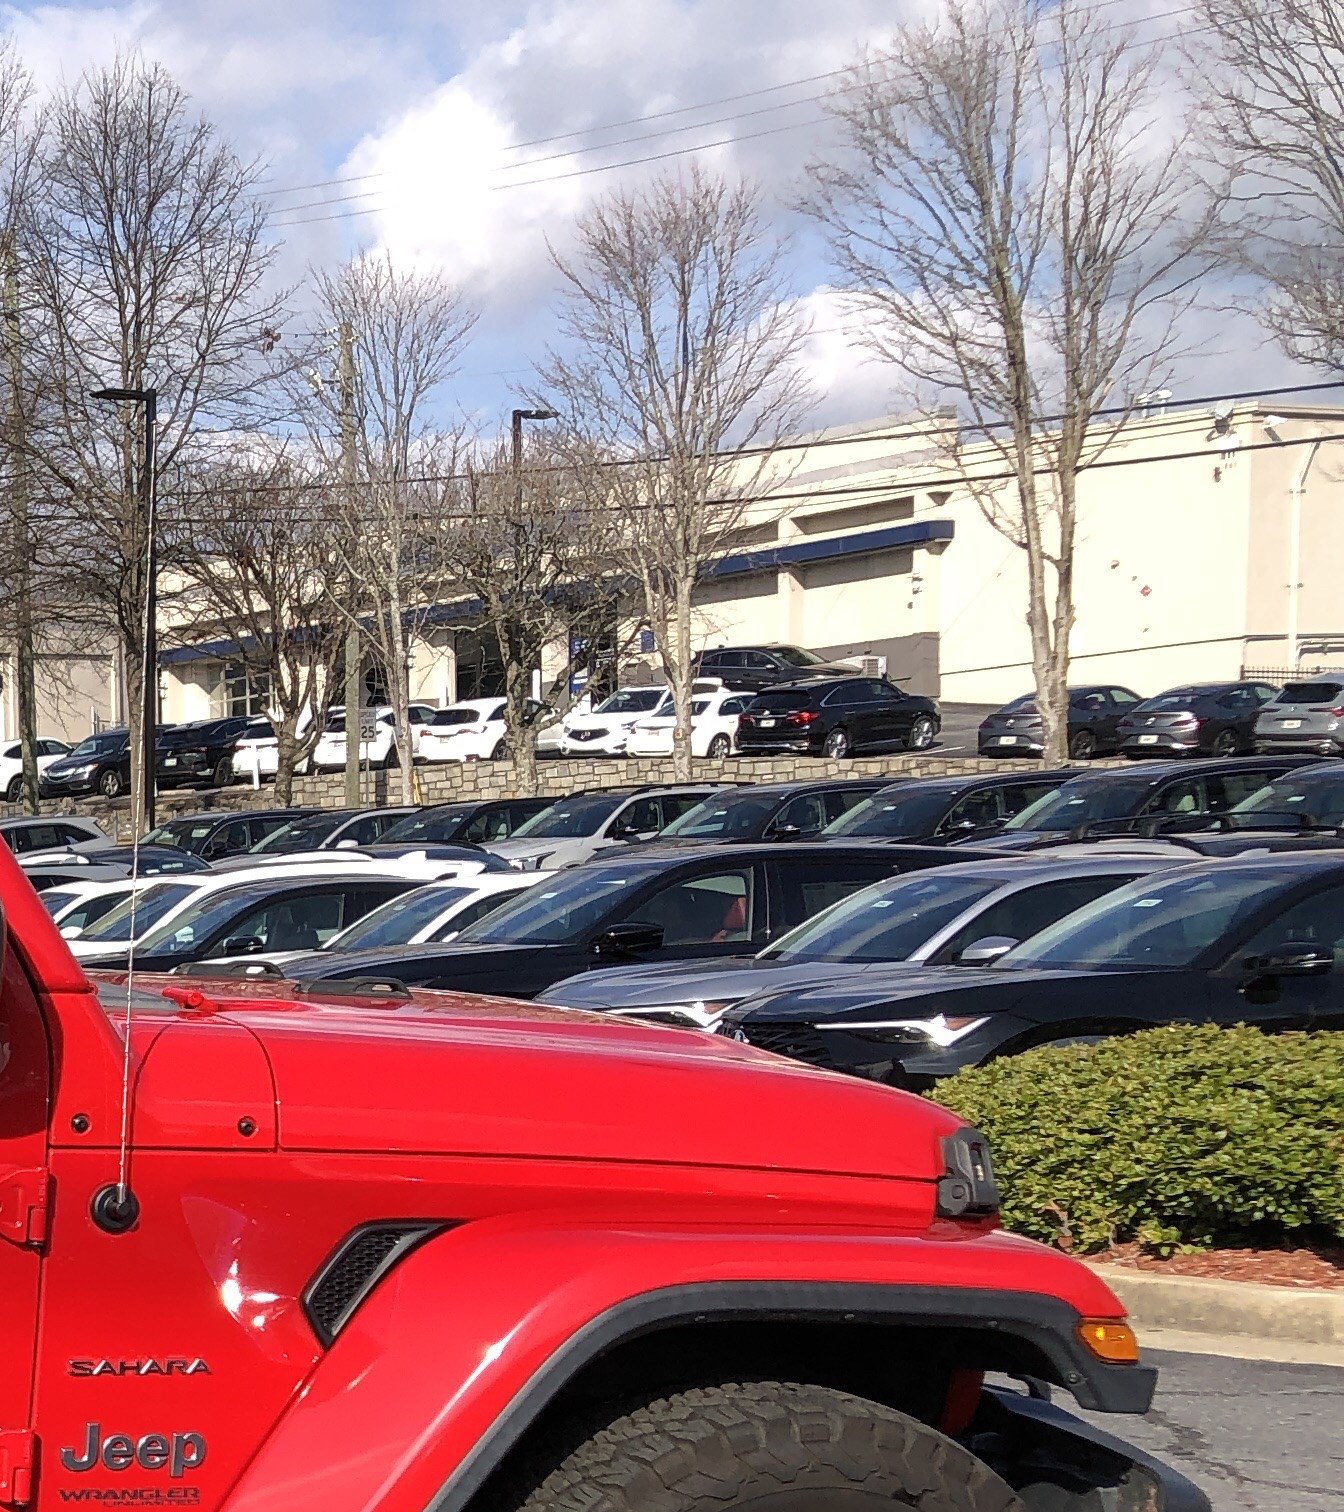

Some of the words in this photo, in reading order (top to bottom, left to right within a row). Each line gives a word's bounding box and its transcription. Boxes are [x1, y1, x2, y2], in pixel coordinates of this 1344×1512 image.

[361, 726, 374, 738] 25
[68, 1357, 210, 1376] SAHARA
[60, 1422, 206, 1477] Jeep
[59, 1488, 200, 1501] WRANGLER
